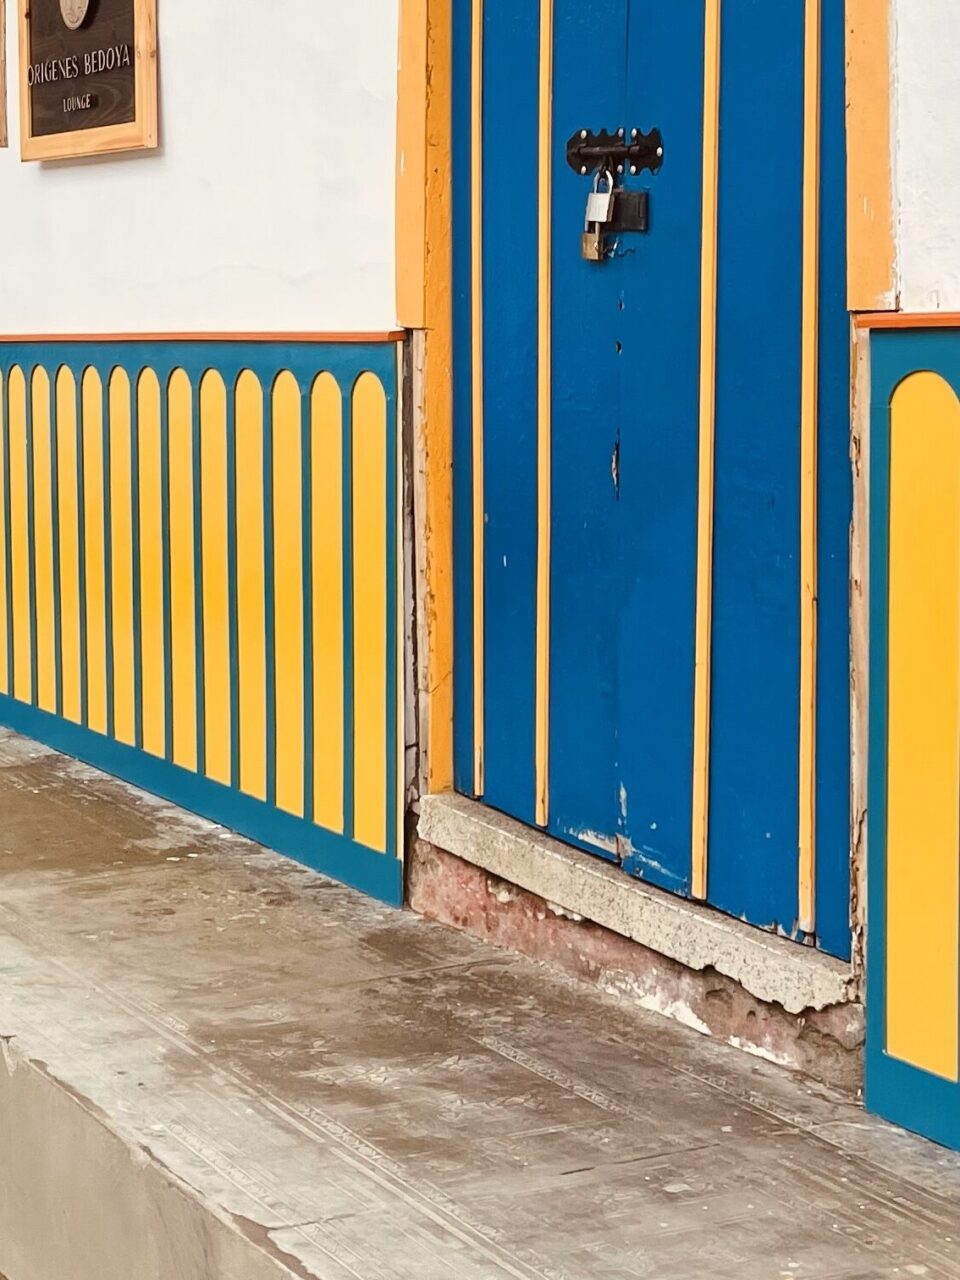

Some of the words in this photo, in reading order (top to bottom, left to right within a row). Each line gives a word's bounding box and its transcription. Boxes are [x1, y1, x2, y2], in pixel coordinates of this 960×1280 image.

[27, 55, 79, 86] ORIGENES
[84, 44, 130, 75] BEDOYA
[63, 93, 91, 113] LOUNGE
